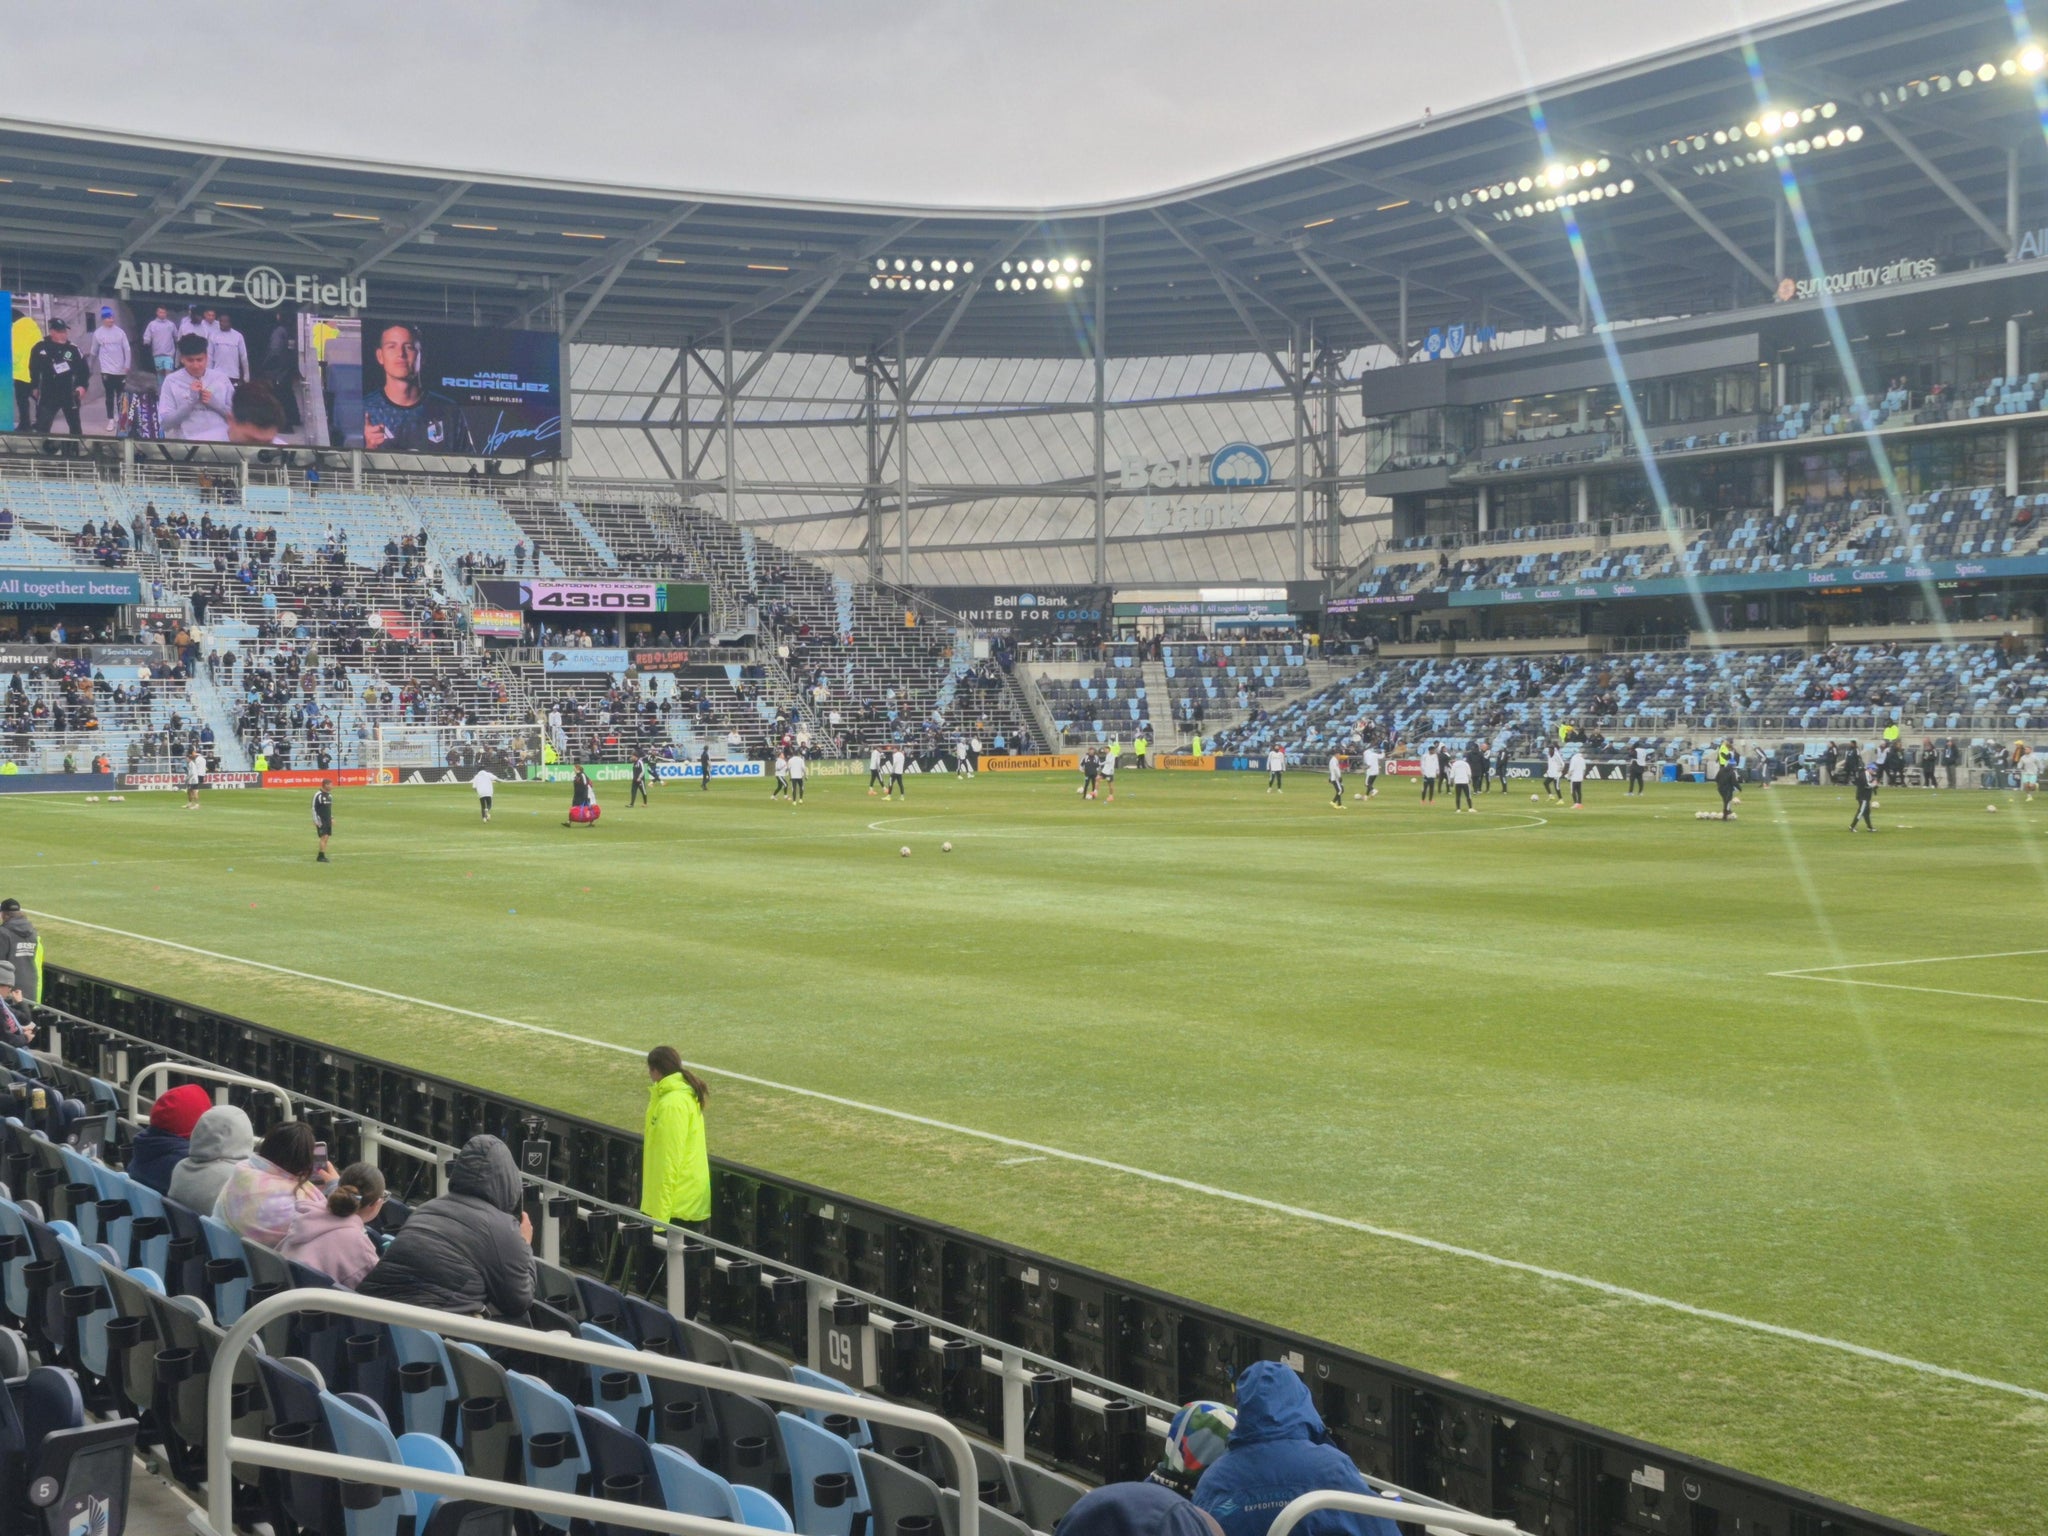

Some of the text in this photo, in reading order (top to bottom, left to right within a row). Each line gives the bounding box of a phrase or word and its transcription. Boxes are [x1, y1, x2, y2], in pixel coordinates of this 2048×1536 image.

[1824, 265, 1880, 293] country
[1881, 257, 1936, 283] airlines
[114, 260, 367, 308] Allianz Field
[474, 371, 518, 380] JAMES
[1121, 455, 1200, 488] Bell
[1808, 563, 1986, 583] Heart. Cancer. Brain. Spine.
[0, 580, 131, 598] All together better.
[538, 592, 651, 607] 43:09
[994, 596, 1068, 606] Bell Bank
[958, 610, 1101, 620] UNITED FOR GOOD
[24, 655, 49, 664] ELITE
[711, 764, 760, 776] ECOLAB
[987, 757, 1071, 771] Continental Tire
[126, 774, 186, 785] DISCOUNT
[596, 766, 633, 780] chim
[829, 1329, 852, 1371] 09
[40, 1483, 50, 1498] 5
